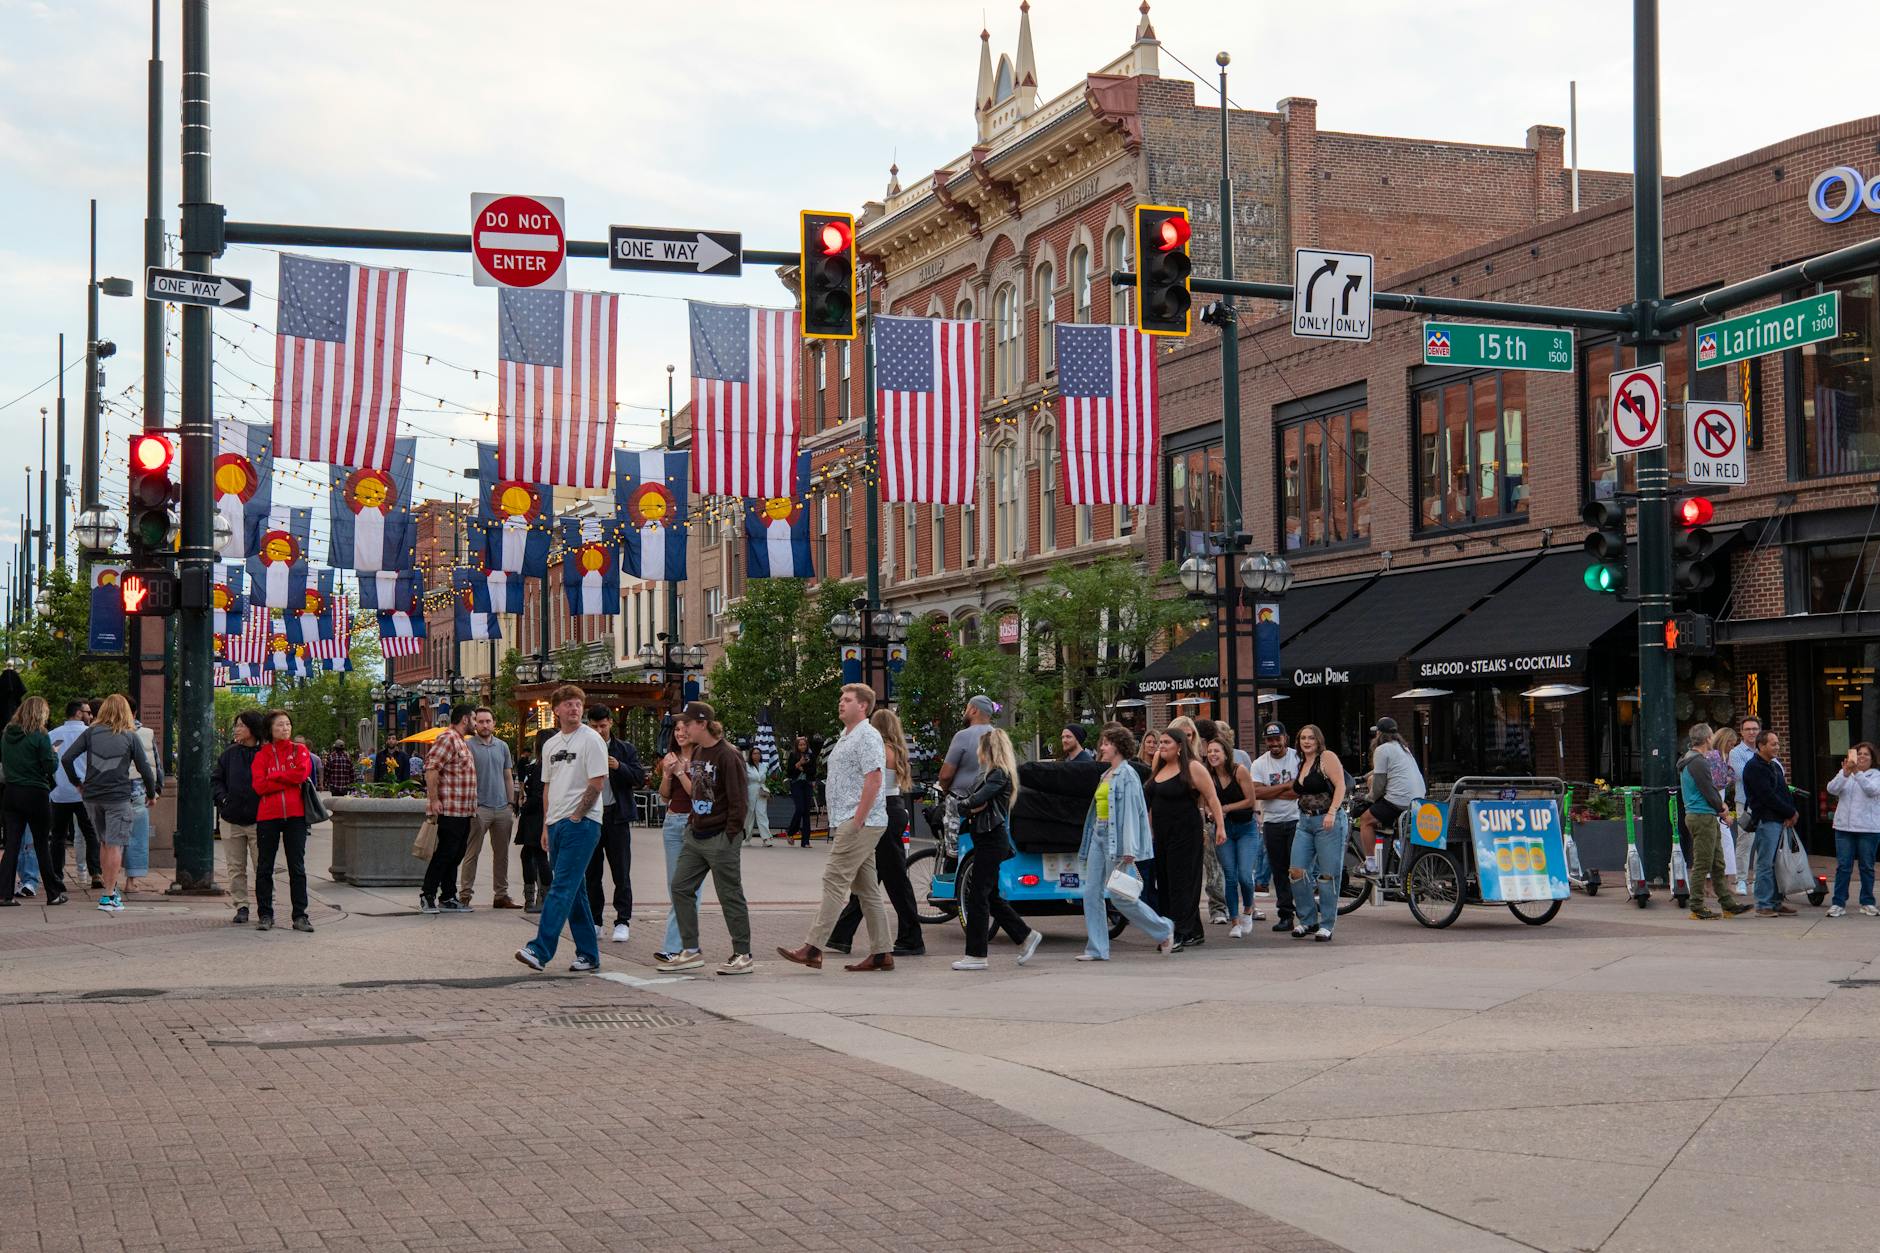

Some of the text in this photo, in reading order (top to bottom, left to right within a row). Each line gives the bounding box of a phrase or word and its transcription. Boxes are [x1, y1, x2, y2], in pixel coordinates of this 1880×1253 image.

[1055, 176, 1100, 214] STANBURY
[486, 212, 551, 230] DO NOT
[621, 240, 698, 260] ONE WAY
[493, 254, 547, 271] ENTER
[919, 259, 945, 283] GALLUP
[158, 278, 220, 297] ONE WAY
[1817, 303, 1827, 317] St
[1299, 315, 1329, 330] ONLY
[1336, 318, 1366, 332] ONLY
[1811, 316, 1834, 333] 1300
[1553, 337, 1563, 350] St
[1723, 314, 1806, 356] Larimer
[1427, 346, 1450, 356] DENVER
[1478, 333, 1527, 361] 15th
[1700, 349, 1717, 360] DENVER
[1548, 351, 1568, 364] 1500
[1694, 461, 1739, 478] ON RED
[1420, 654, 1572, 676] SEAFOOD STEAKS COCKTAILS
[1139, 681, 1167, 692] SEAFOOD
[1171, 678, 1194, 690] STEAKS
[1478, 808, 1552, 832] SUN'S UP
